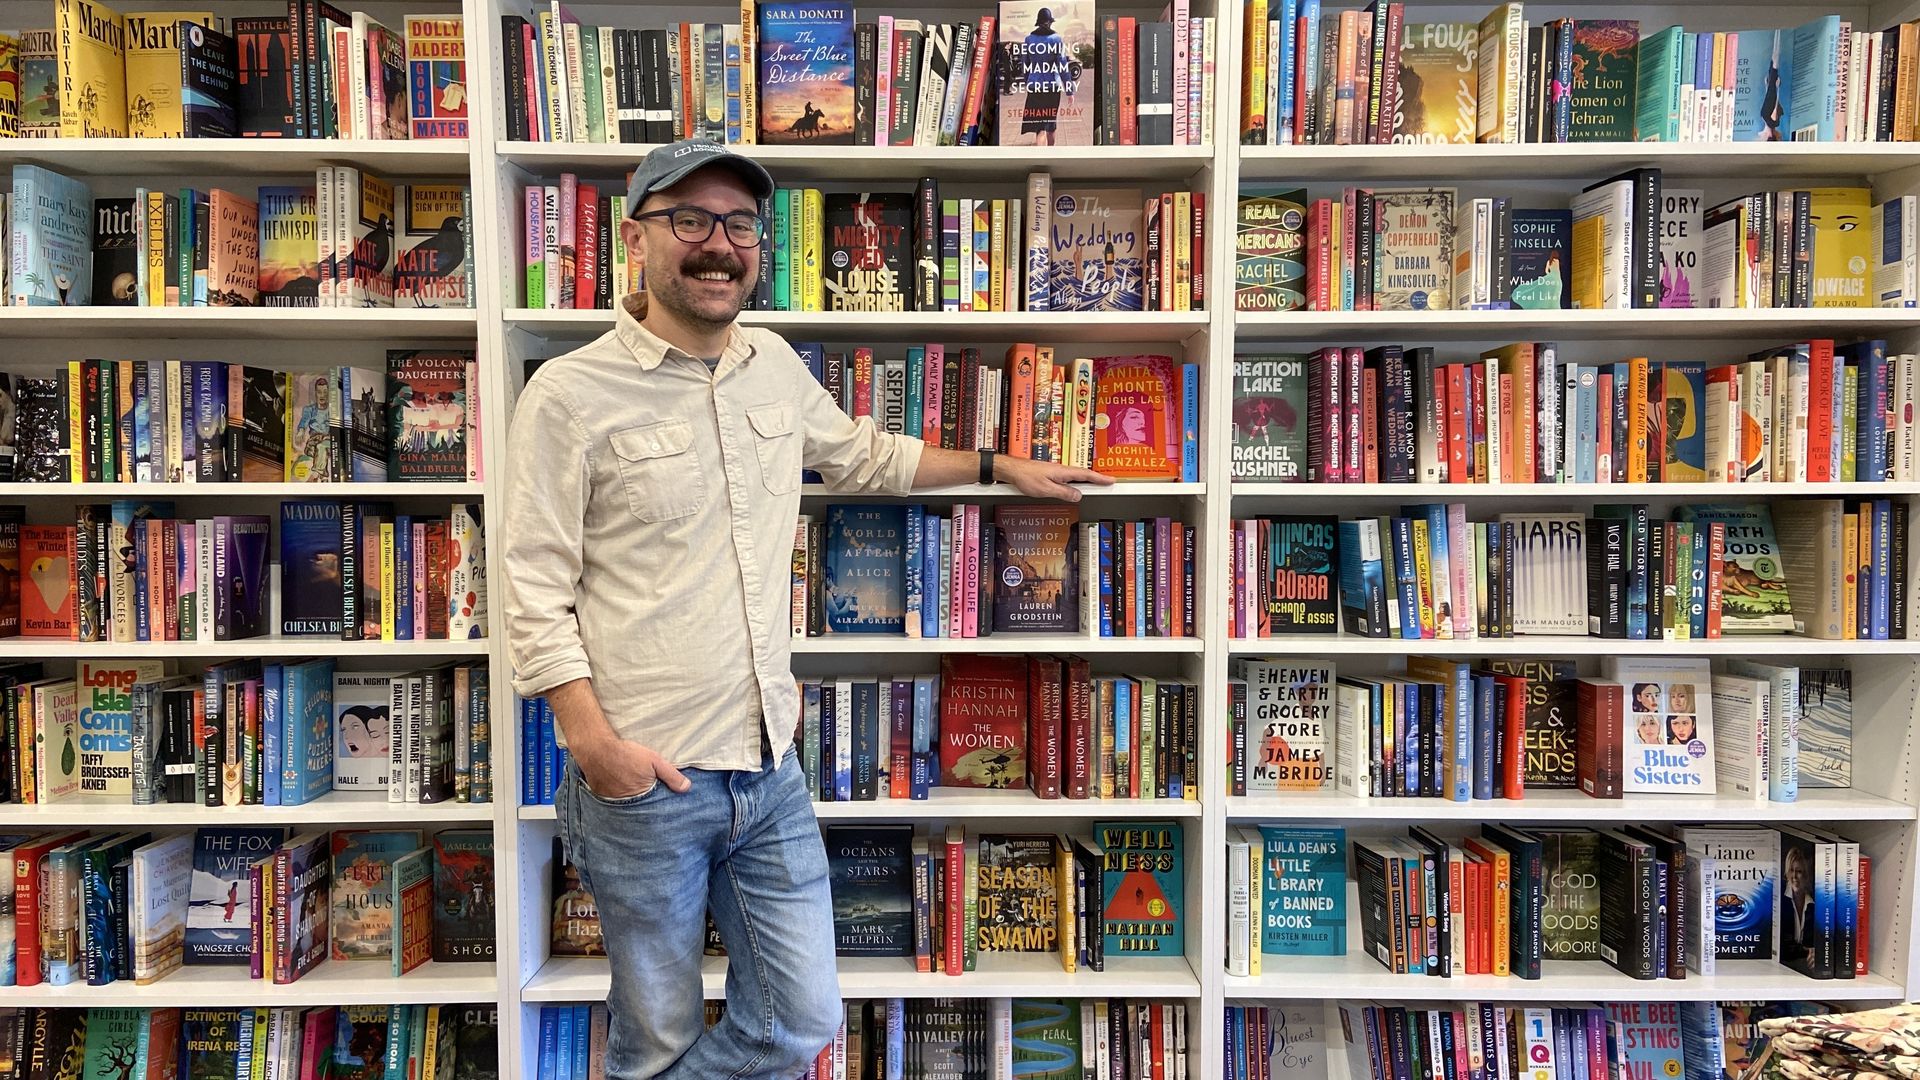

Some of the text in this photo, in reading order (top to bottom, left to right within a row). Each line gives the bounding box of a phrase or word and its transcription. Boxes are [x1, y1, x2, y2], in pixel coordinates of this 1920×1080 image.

[767, 11, 843, 19] SARA DONATI
[291, 2, 299, 62] ENTITLEMENT
[412, 21, 458, 36] DOLLY
[796, 31, 815, 44] The
[202, 48, 225, 63] LEAVE
[765, 45, 846, 62] Sweet Blue
[1013, 43, 1080, 54] BECOMING
[585, 33, 595, 80] TRUST
[190, 57, 234, 79] THE WORLD
[767, 65, 844, 84] Distance
[1024, 62, 1069, 73] MADAM
[201, 74, 229, 91] BEHIND
[292, 64, 301, 98] RUMAAN
[545, 19, 562, 140] DEAR DICKHEAD DESPENTES
[1595, 80, 1622, 89] Lion
[1839, 59, 1849, 113] KAWAKAMI
[417, 63, 425, 117] GOOD
[1012, 82, 1080, 93] SECRETARY
[1008, 107, 1084, 117] STEPHANIE DRAY
[1570, 113, 1614, 124] Tehran
[853, 204, 885, 224] THE
[1082, 197, 1111, 218] The
[1246, 204, 1280, 220] REAL
[40, 216, 87, 238] andrews
[530, 192, 539, 258] HOUSEMATES
[545, 194, 558, 254] will self
[1400, 214, 1427, 228] DEMON
[149, 197, 162, 268] IXELLES
[1513, 224, 1556, 234] SOPHIE
[584, 204, 593, 280] SCAFFOLDING
[835, 226, 900, 247] MIGHTY
[1054, 224, 1135, 252] Wedding
[1149, 230, 1157, 251] RIPE
[1387, 232, 1438, 246] COPPERHEAD
[1511, 239, 1562, 248] INSELLA
[397, 250, 438, 272] KATE
[851, 249, 884, 269] RED
[1395, 257, 1430, 270] BARBARA
[1237, 264, 1288, 278] RACHEL
[837, 271, 898, 292] LOUISE
[1081, 266, 1136, 294] People
[1388, 274, 1437, 289] KINGSOLVER
[1239, 294, 1286, 308] KHONG
[391, 359, 413, 368] THE
[397, 371, 467, 379] DAUGHTERS
[1107, 367, 1151, 378] ANITA
[929, 352, 938, 413] FAMILY FAMILY
[1113, 380, 1164, 393] MONTE
[1243, 377, 1283, 392] LAKE
[1404, 370, 1412, 404] EXHIBIT
[1140, 395, 1168, 404] LAST
[1637, 363, 1646, 436] GLORIOUS EXPLOITS
[400, 453, 428, 461] GINA
[1107, 446, 1157, 455] XOCHITL
[1233, 446, 1290, 460] RACHEL
[401, 464, 466, 473] BALIBRERA
[1097, 457, 1167, 467] GONZALEZ
[1001, 518, 1070, 527] WE MUST NOT
[844, 529, 896, 537] WORLD
[1012, 532, 1059, 541] THINK OF
[38, 541, 67, 551] Winter
[1637, 509, 1646, 576] COLD VICTORY
[1653, 527, 1661, 557] LILITH
[216, 524, 225, 578] BEAUTYLAND
[846, 548, 893, 558] AFTER
[1008, 547, 1063, 557] OURSELVES
[344, 505, 353, 629] MADWOMAN CHELSEA BIEKER
[847, 569, 891, 577] ALICE
[1276, 569, 1328, 600] BORBA
[1010, 612, 1062, 621] GRODSTEIN
[25, 619, 50, 630] Kevin
[284, 621, 325, 633] CHELSEA
[84, 664, 137, 692] Long
[1268, 668, 1329, 684] HEAVEN
[951, 685, 1015, 699] KRISTIN
[1259, 687, 1328, 700] & EARTH
[206, 679, 217, 720] REDNECKS
[947, 703, 1018, 717] HANNAH
[1257, 705, 1330, 719] GROCERY
[392, 684, 403, 764] BANAL NIGHTMARE
[974, 723, 992, 733] THE
[1266, 724, 1320, 737] STORE
[950, 734, 1015, 748] WOMEN
[81, 754, 104, 766] TAFFY
[1047, 739, 1056, 778] WOMEN
[1265, 749, 1321, 762] JAMES
[1644, 749, 1689, 768] Blue
[81, 767, 132, 779] BRODESSER-
[338, 776, 359, 784] HALLE
[1253, 766, 1333, 780] McBRIDE
[1634, 766, 1701, 785] Sisters
[81, 779, 107, 791] AKNER
[204, 835, 272, 851] THE FOX
[444, 842, 470, 850] JAMES
[1106, 829, 1173, 851] WELL
[841, 846, 895, 857] OCEANS
[1268, 841, 1337, 854] LULA DEAN'S
[1705, 844, 1755, 861] Liane
[216, 856, 254, 871] WIFE
[1104, 851, 1173, 872] NESS
[1268, 858, 1311, 872] LITTLE
[847, 866, 889, 876] STARS
[979, 867, 1056, 889] SEASON
[1551, 874, 1597, 888] GOD
[979, 897, 1056, 919] OF THE
[1268, 896, 1334, 911] of BANNED
[1564, 895, 1585, 909] THE
[1268, 914, 1312, 928] BOOKS
[851, 925, 884, 934] MARK
[1105, 923, 1173, 936] NATHAN
[1268, 932, 1329, 941] KIRSTEN MILLER
[842, 934, 894, 944] HELPRIN
[979, 927, 1056, 949] SWAMP
[1119, 937, 1159, 951] HILL
[193, 943, 224, 953] YANGSZE
[1543, 941, 1597, 953] MOORE
[92, 1010, 120, 1020] WEIRD
[925, 1013, 962, 1025] OTHER
[1608, 1003, 1678, 1024] THE BEE
[108, 1022, 134, 1033] GIRLS
[209, 1026, 226, 1037] OF
[30, 1009, 47, 1072] ARGYLLE
[923, 1031, 964, 1043] VALLEY
[1043, 1029, 1073, 1041] PEARL
[1626, 1027, 1680, 1049] STING
[187, 1041, 220, 1051] IRENA
[933, 1062, 954, 1070] SCOTT
